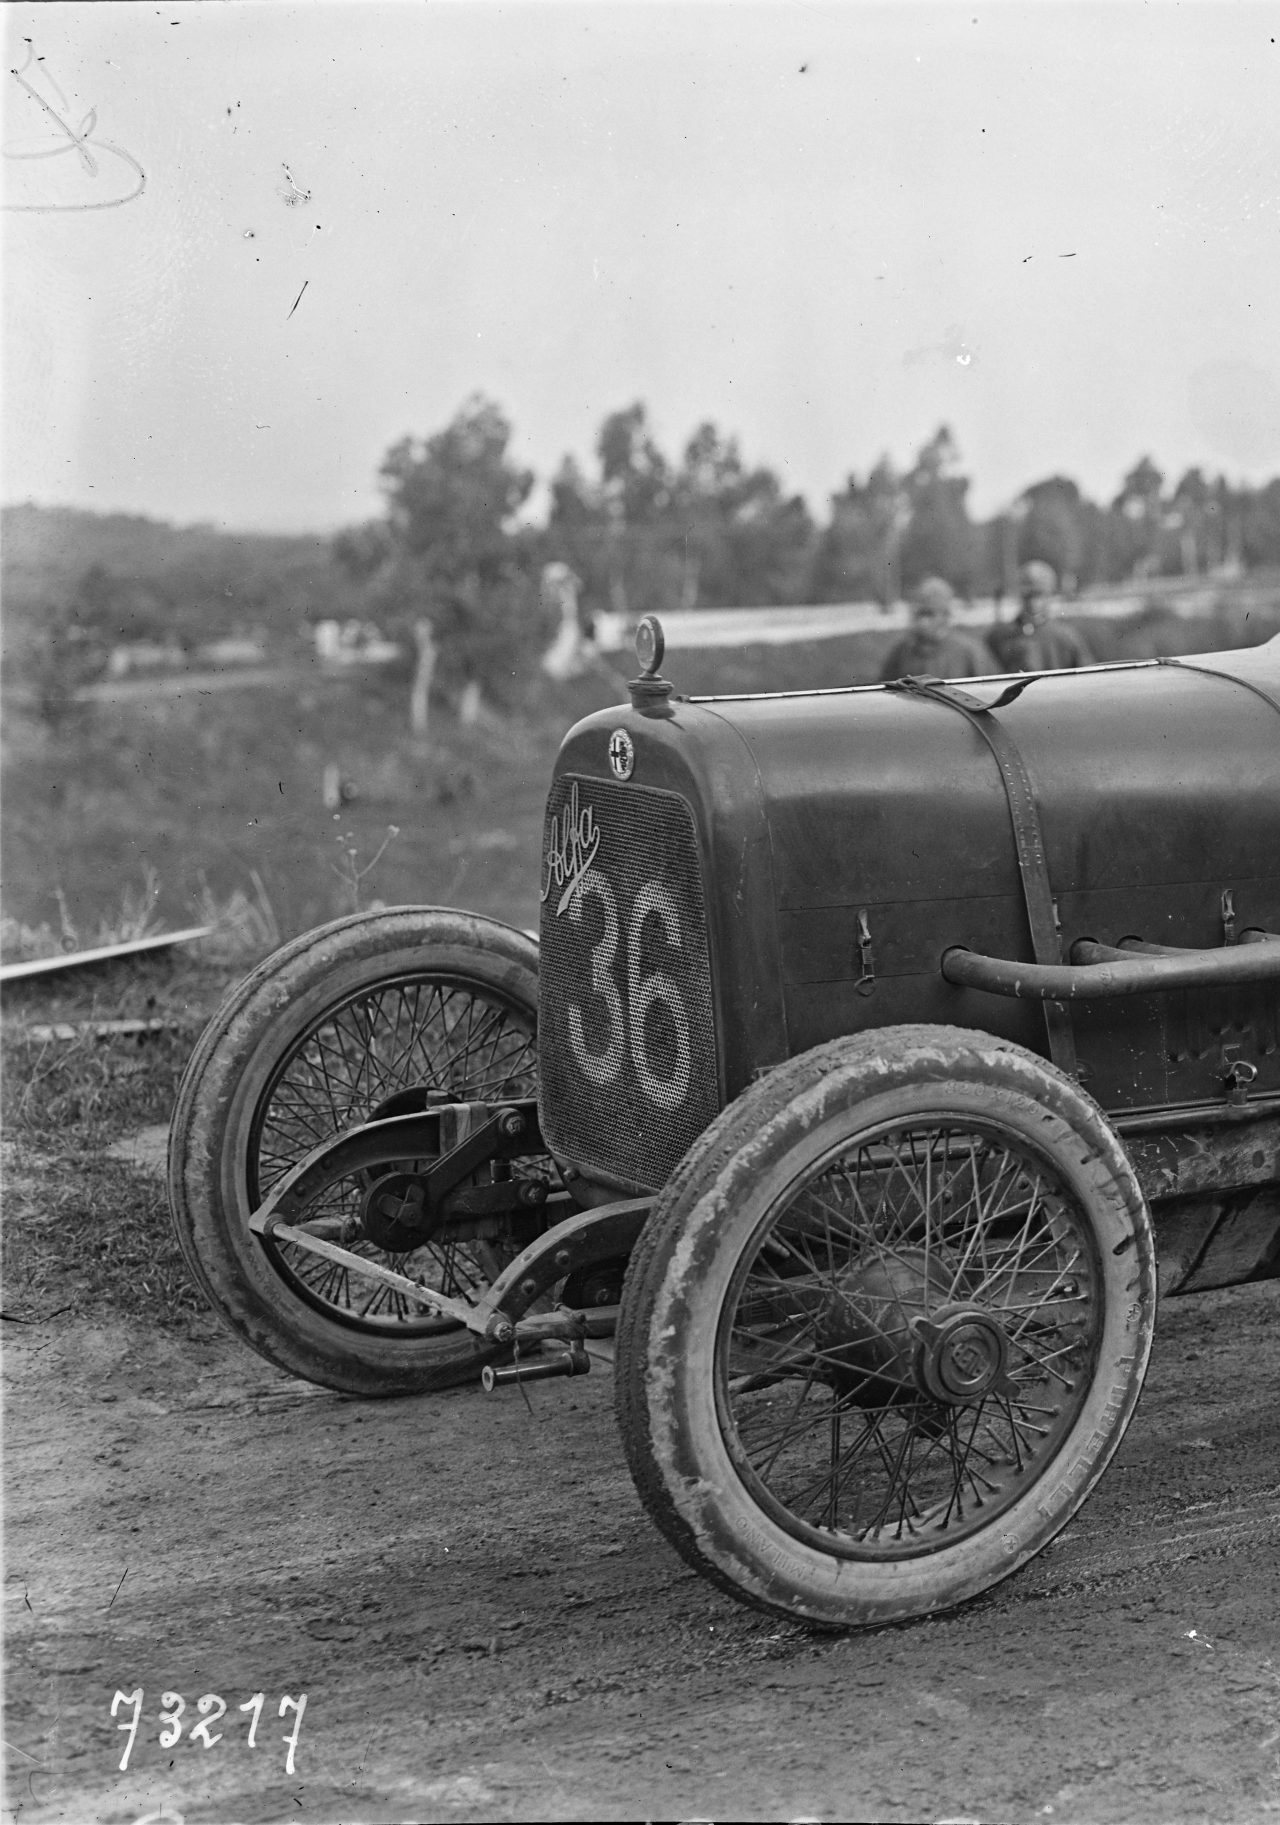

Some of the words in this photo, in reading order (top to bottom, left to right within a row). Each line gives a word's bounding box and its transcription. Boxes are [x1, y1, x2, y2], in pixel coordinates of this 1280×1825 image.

[540, 782, 601, 916] Alfa
[568, 869, 690, 1110] 36
[1038, 1354, 1137, 1517] PIRELLI
